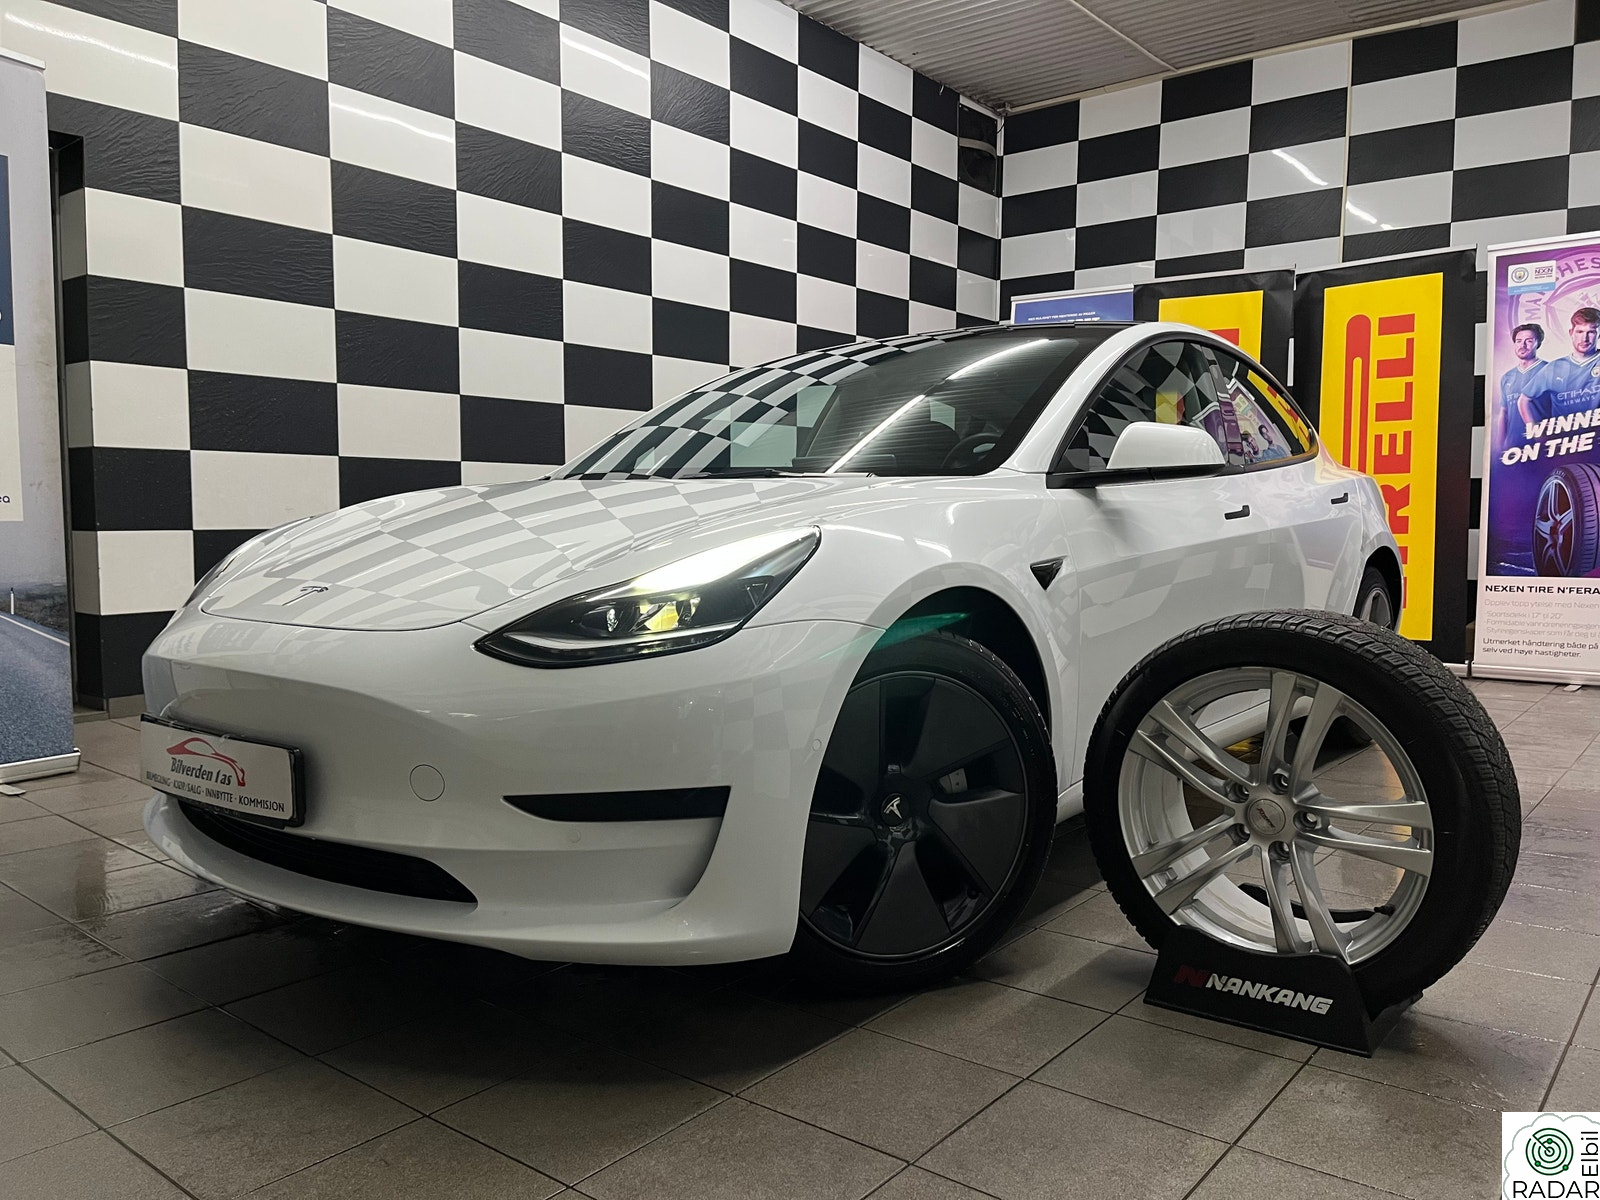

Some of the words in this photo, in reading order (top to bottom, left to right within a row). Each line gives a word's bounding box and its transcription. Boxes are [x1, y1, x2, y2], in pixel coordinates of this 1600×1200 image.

[1501, 442, 1540, 465] ON
[1545, 432, 1595, 457] THE
[1485, 585, 1524, 593] NEXEN
[1512, 600, 1529, 608] topp
[1522, 640, 1565, 649] håndtering
[1588, 642, 1599, 650] på
[1534, 649, 1581, 658] hastigheter.
[170, 756, 213, 782] Bilverden
[220, 773, 232, 786] as
[205, 787, 233, 803] INNBYTTE
[238, 795, 285, 813] KOMMISJON
[1205, 973, 1334, 1015] NANKANG
